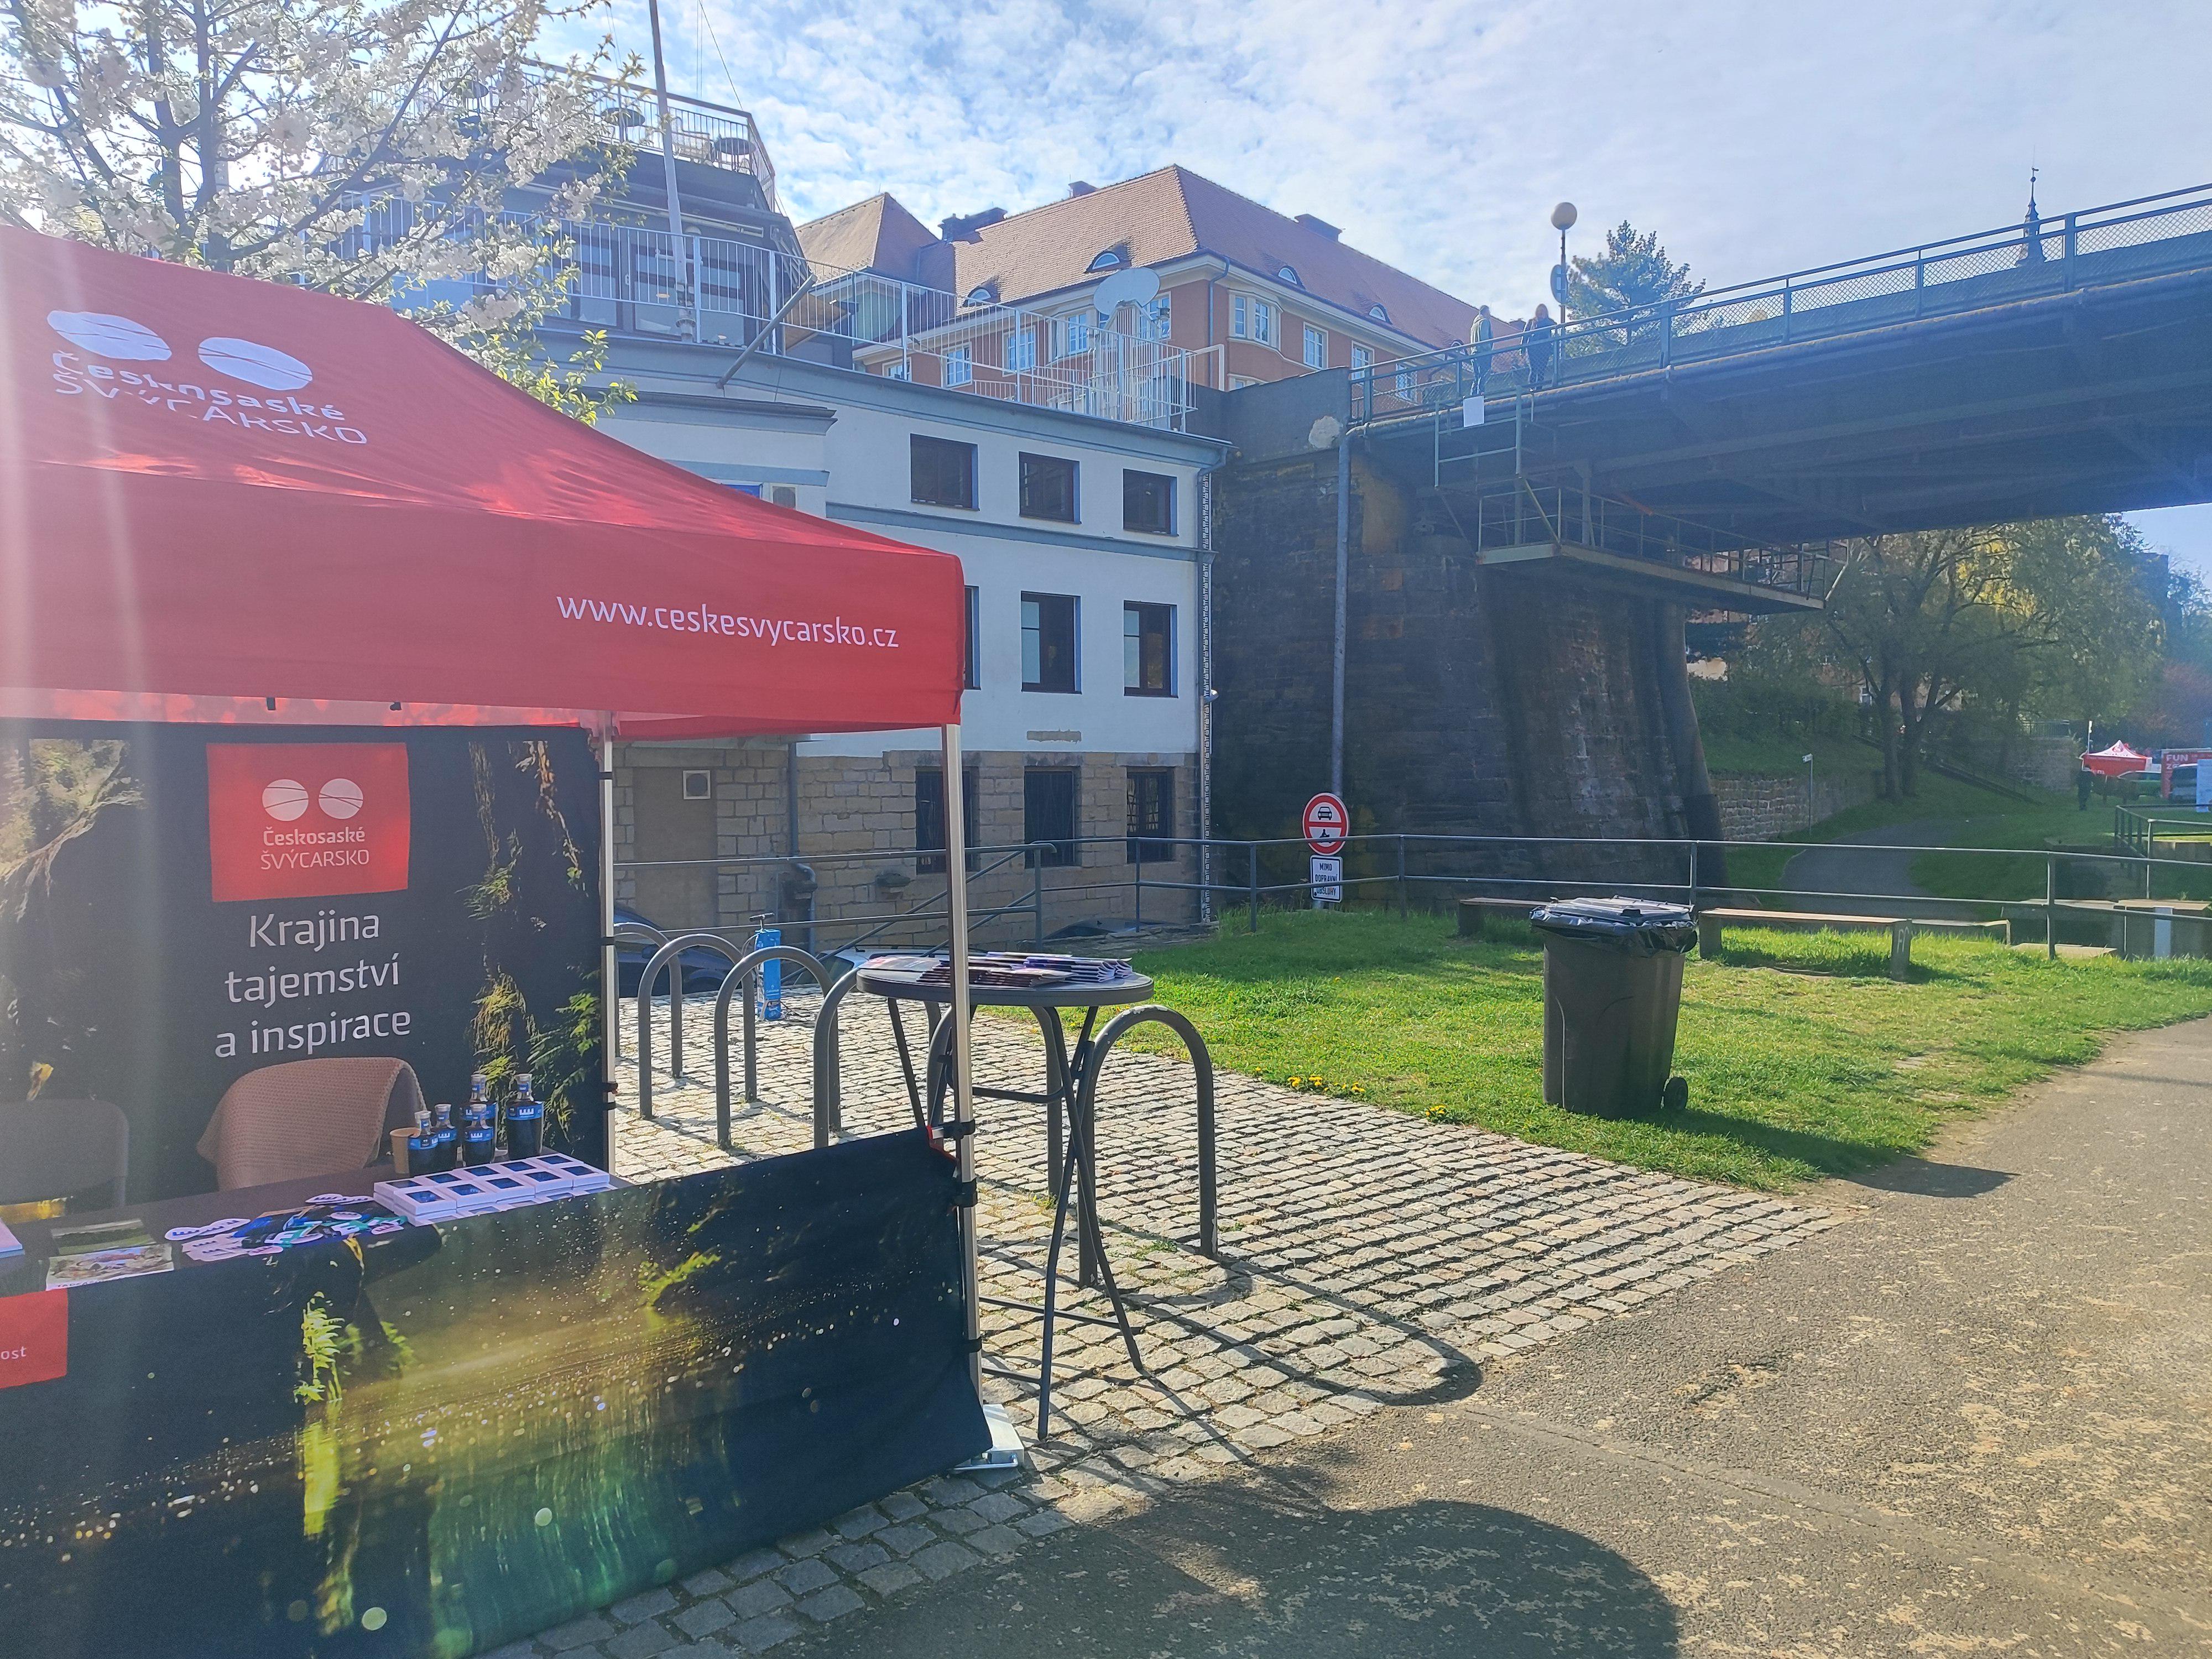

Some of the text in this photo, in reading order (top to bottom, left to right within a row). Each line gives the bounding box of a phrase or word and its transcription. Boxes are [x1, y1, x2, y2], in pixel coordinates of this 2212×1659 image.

[556, 596, 899, 648] www.ceskesvycarsko.cz
[263, 826, 366, 847] Českosaské
[261, 848, 369, 870] ŠVÝCARSKO
[1319, 863, 1332, 871] MIMO
[1315, 874, 1338, 882] DOPRAVNÍ
[250, 910, 379, 952] Krajina
[224, 952, 399, 1008] tajemství
[215, 1011, 411, 1057] a inspirace
